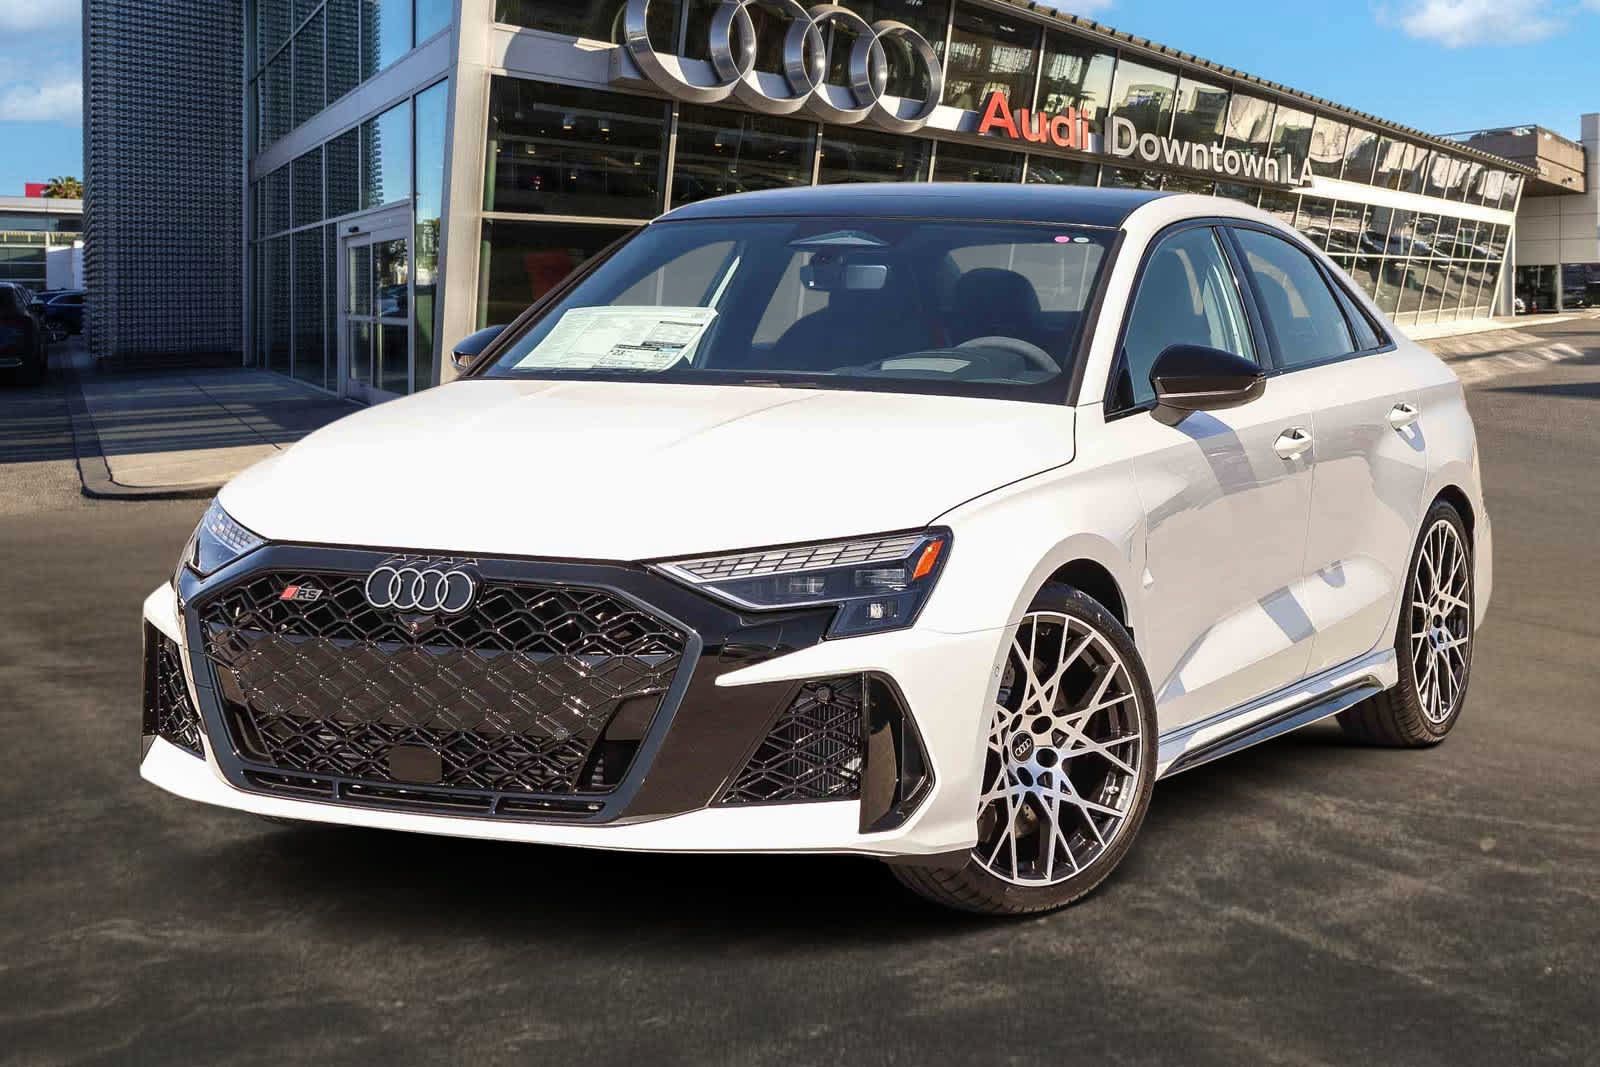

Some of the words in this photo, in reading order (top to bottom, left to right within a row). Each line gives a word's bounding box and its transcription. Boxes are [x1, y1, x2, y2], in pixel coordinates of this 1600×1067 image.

[978, 90, 1089, 151] Audi
[1109, 116, 1279, 183] Downtown
[1287, 153, 1314, 188] LA
